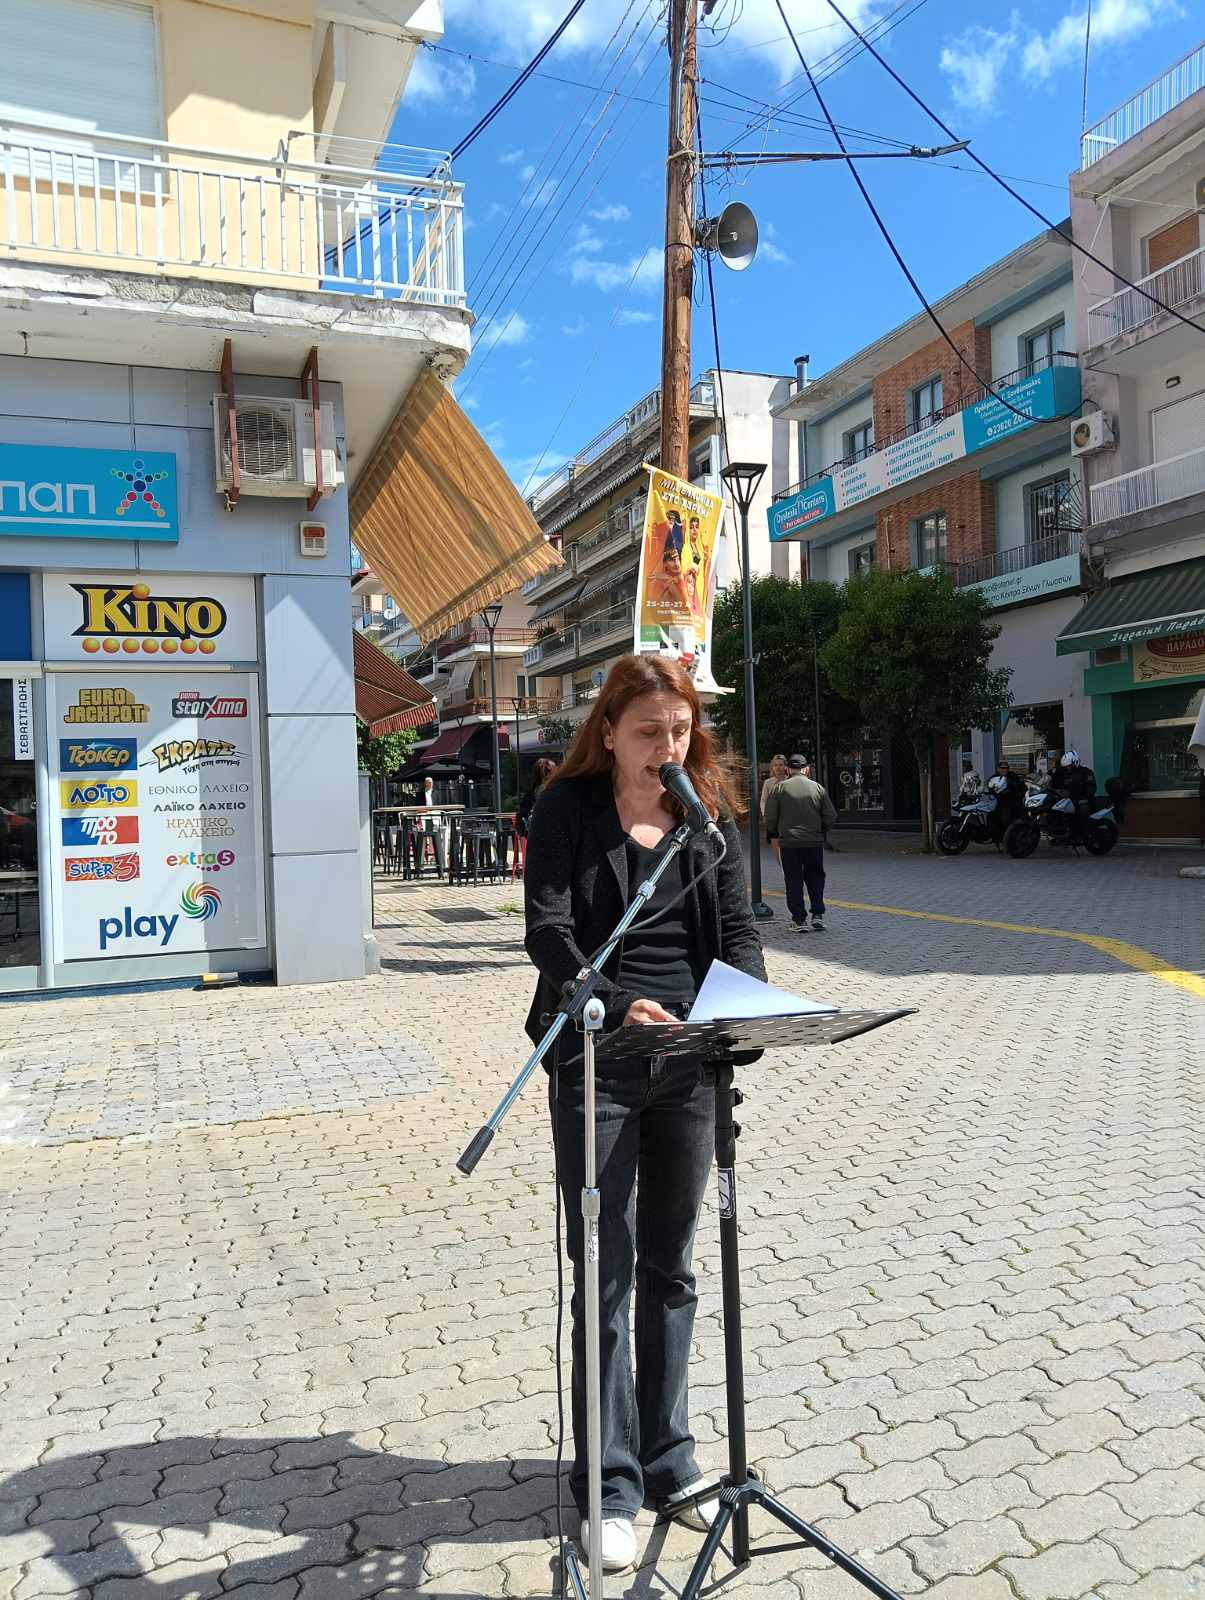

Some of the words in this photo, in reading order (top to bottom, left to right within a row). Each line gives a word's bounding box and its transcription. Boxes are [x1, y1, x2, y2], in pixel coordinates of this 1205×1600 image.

[79, 688, 127, 705] EURO
[18, 678, 29, 754] ΣΕΒΑΣΤΙΑΔΗΣ
[64, 704, 145, 723] JACKPOT
[148, 785, 198, 795] ΕΘΝΙΚΟ
[202, 783, 249, 793] ΛΑΧΕΙΟ
[153, 802, 195, 812] ΛΑΪΚΟ
[198, 802, 246, 811] ΛΑΧΕΙΟ
[167, 817, 228, 828] ΚΡΑΤΙΚΟ
[70, 861, 113, 878] SUPER
[99, 906, 179, 950] play
